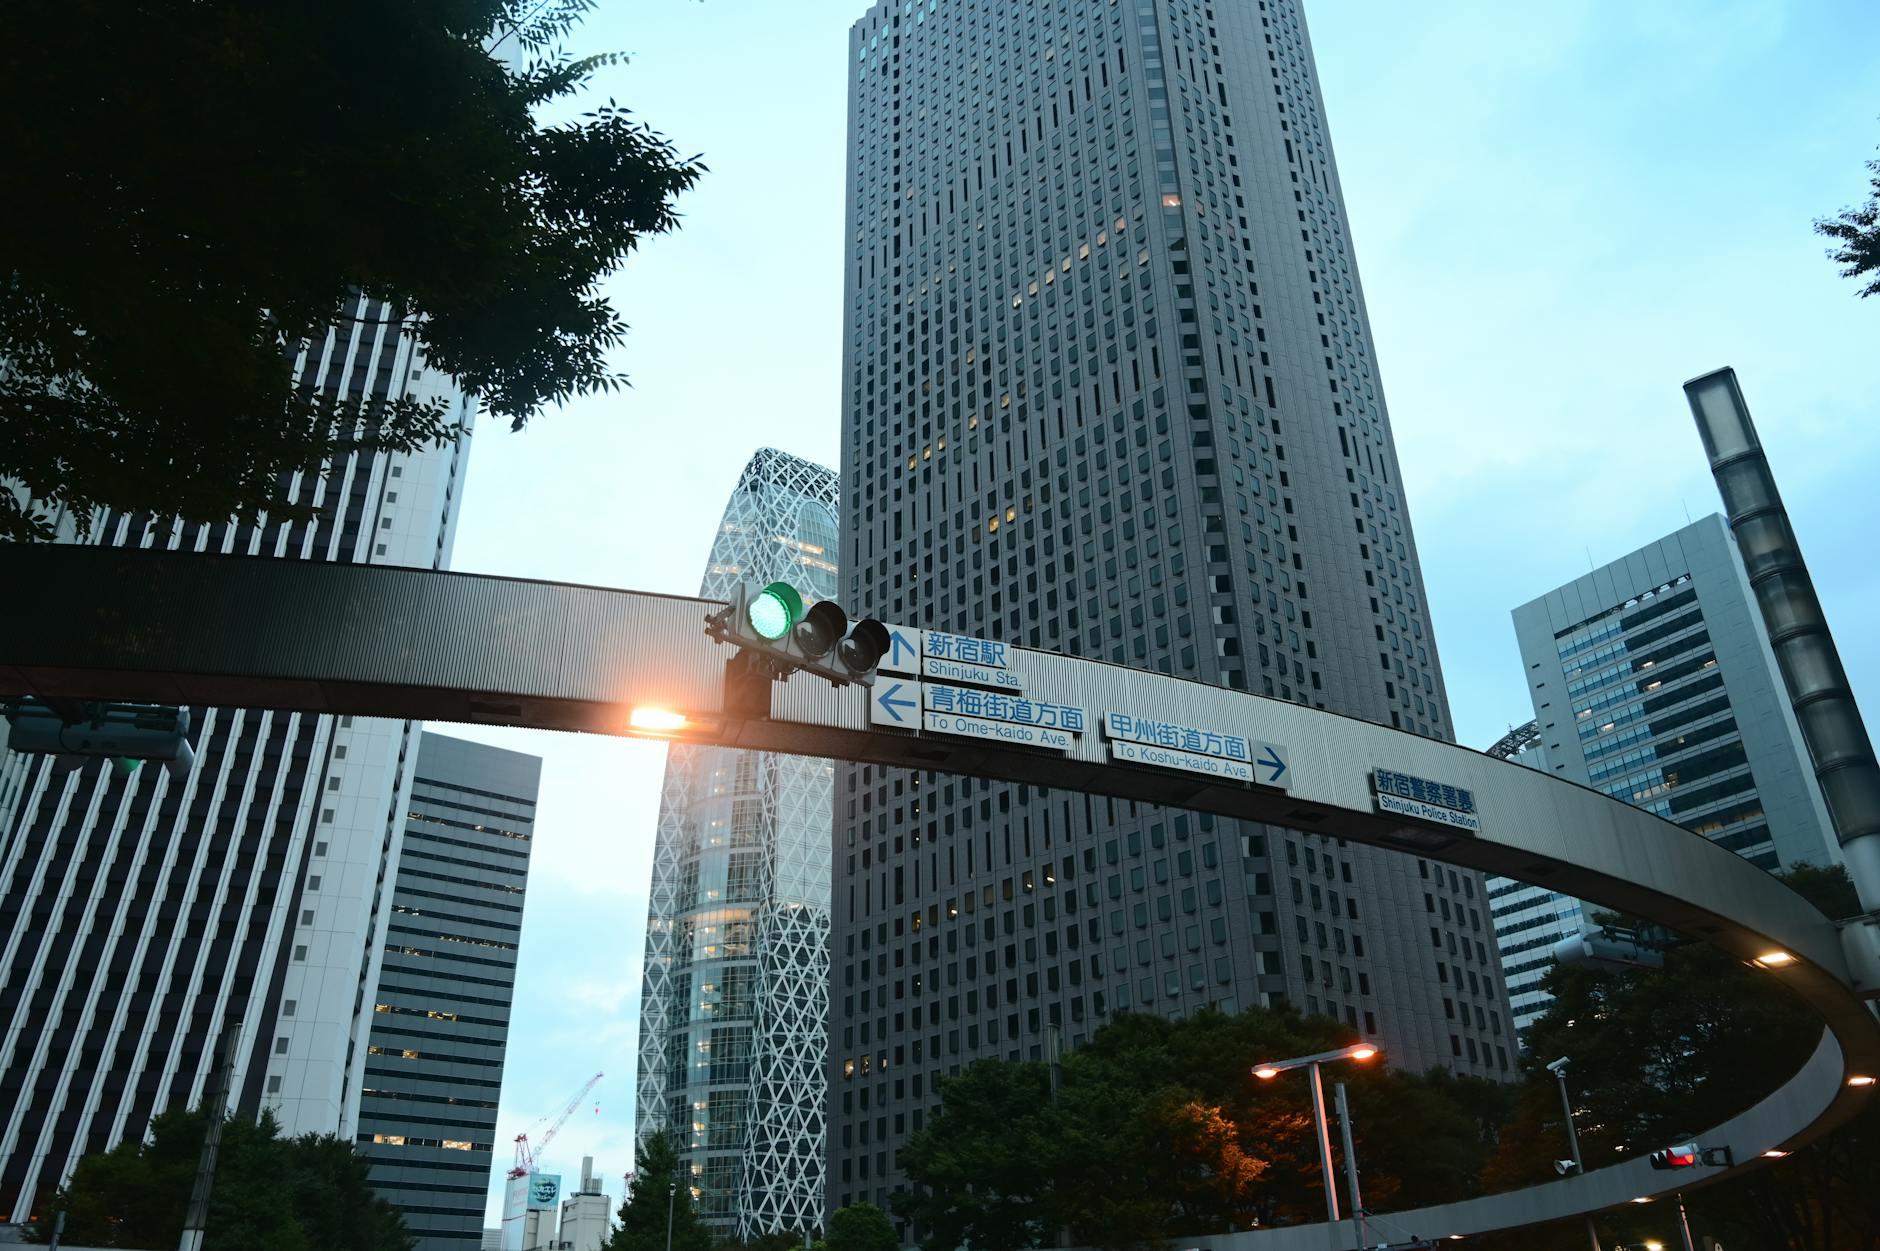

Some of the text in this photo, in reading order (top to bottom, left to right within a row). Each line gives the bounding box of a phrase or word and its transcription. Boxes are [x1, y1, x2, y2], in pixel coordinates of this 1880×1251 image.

[928, 631, 1006, 666] 新宿駅
[929, 661, 1022, 687] Shinjuku Sta.
[930, 685, 1084, 731] 青梅街道方面
[930, 714, 1069, 746] To Ome-kaido Ave.
[1110, 713, 1246, 760] 甲州街道方面
[1118, 743, 1250, 779] To Koshu-kaido Ave.
[1377, 769, 1474, 811] 新宿警察署裏
[1381, 795, 1478, 829] Shinjuku Police Station
